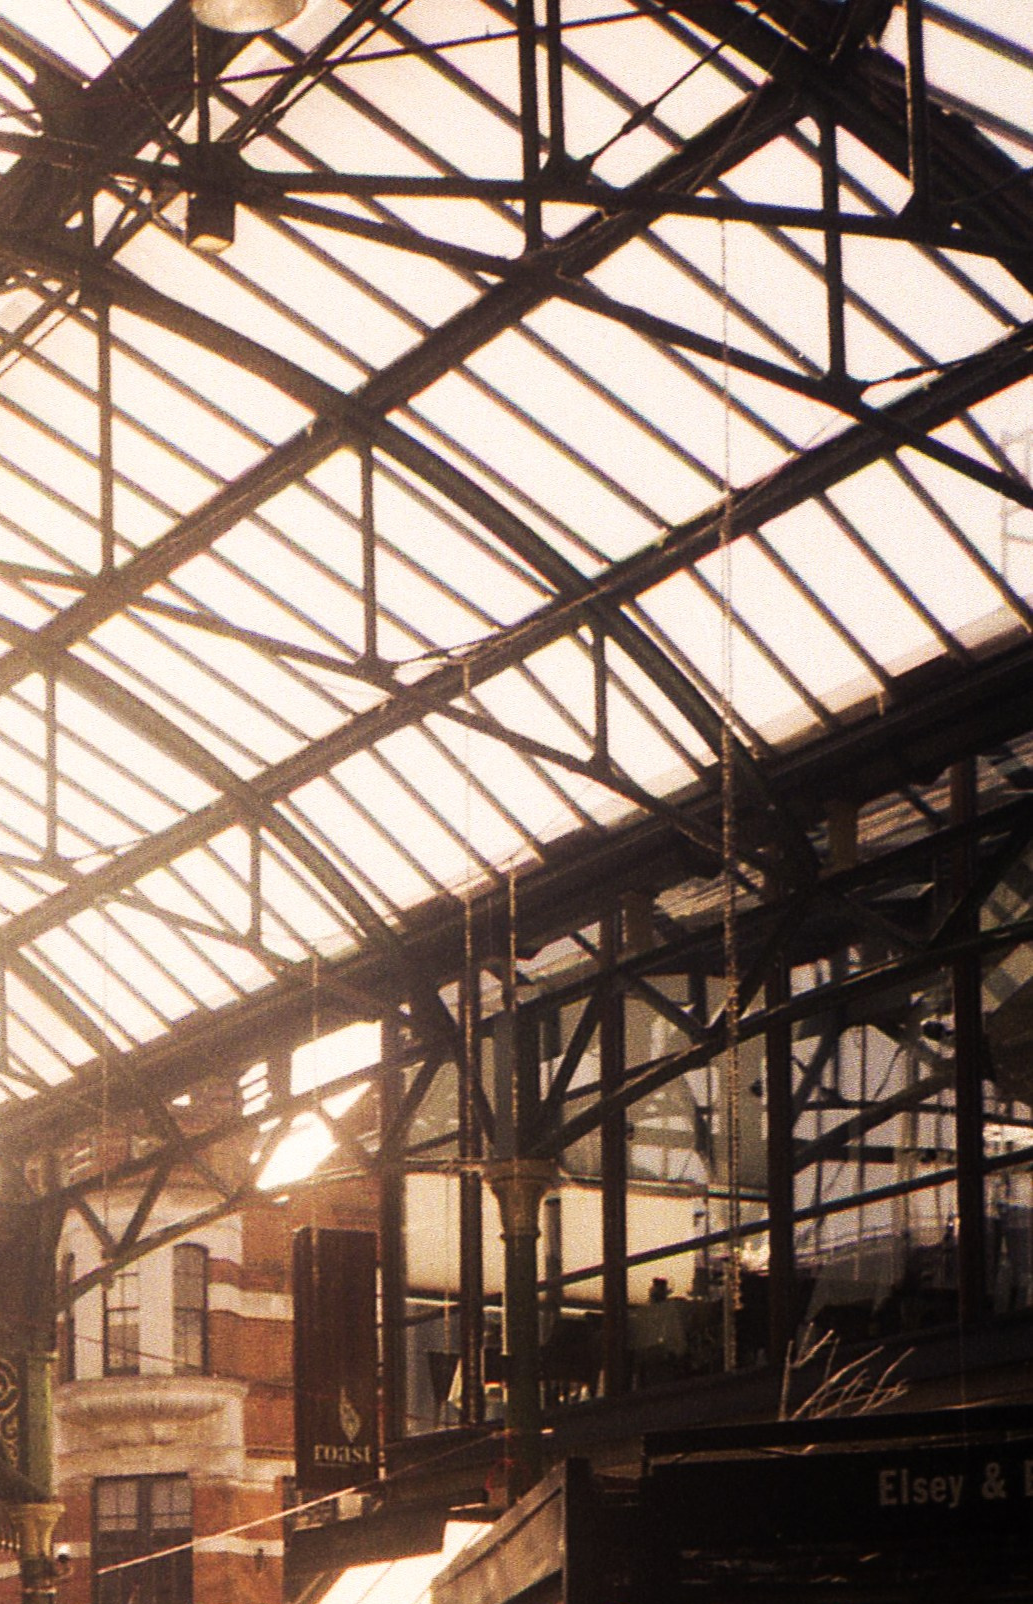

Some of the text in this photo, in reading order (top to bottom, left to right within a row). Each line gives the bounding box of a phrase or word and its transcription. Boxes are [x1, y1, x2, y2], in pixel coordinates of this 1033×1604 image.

[313, 1444, 372, 1463] roast
[878, 1467, 964, 1509] Elsey
[981, 1461, 1007, 1500] &
